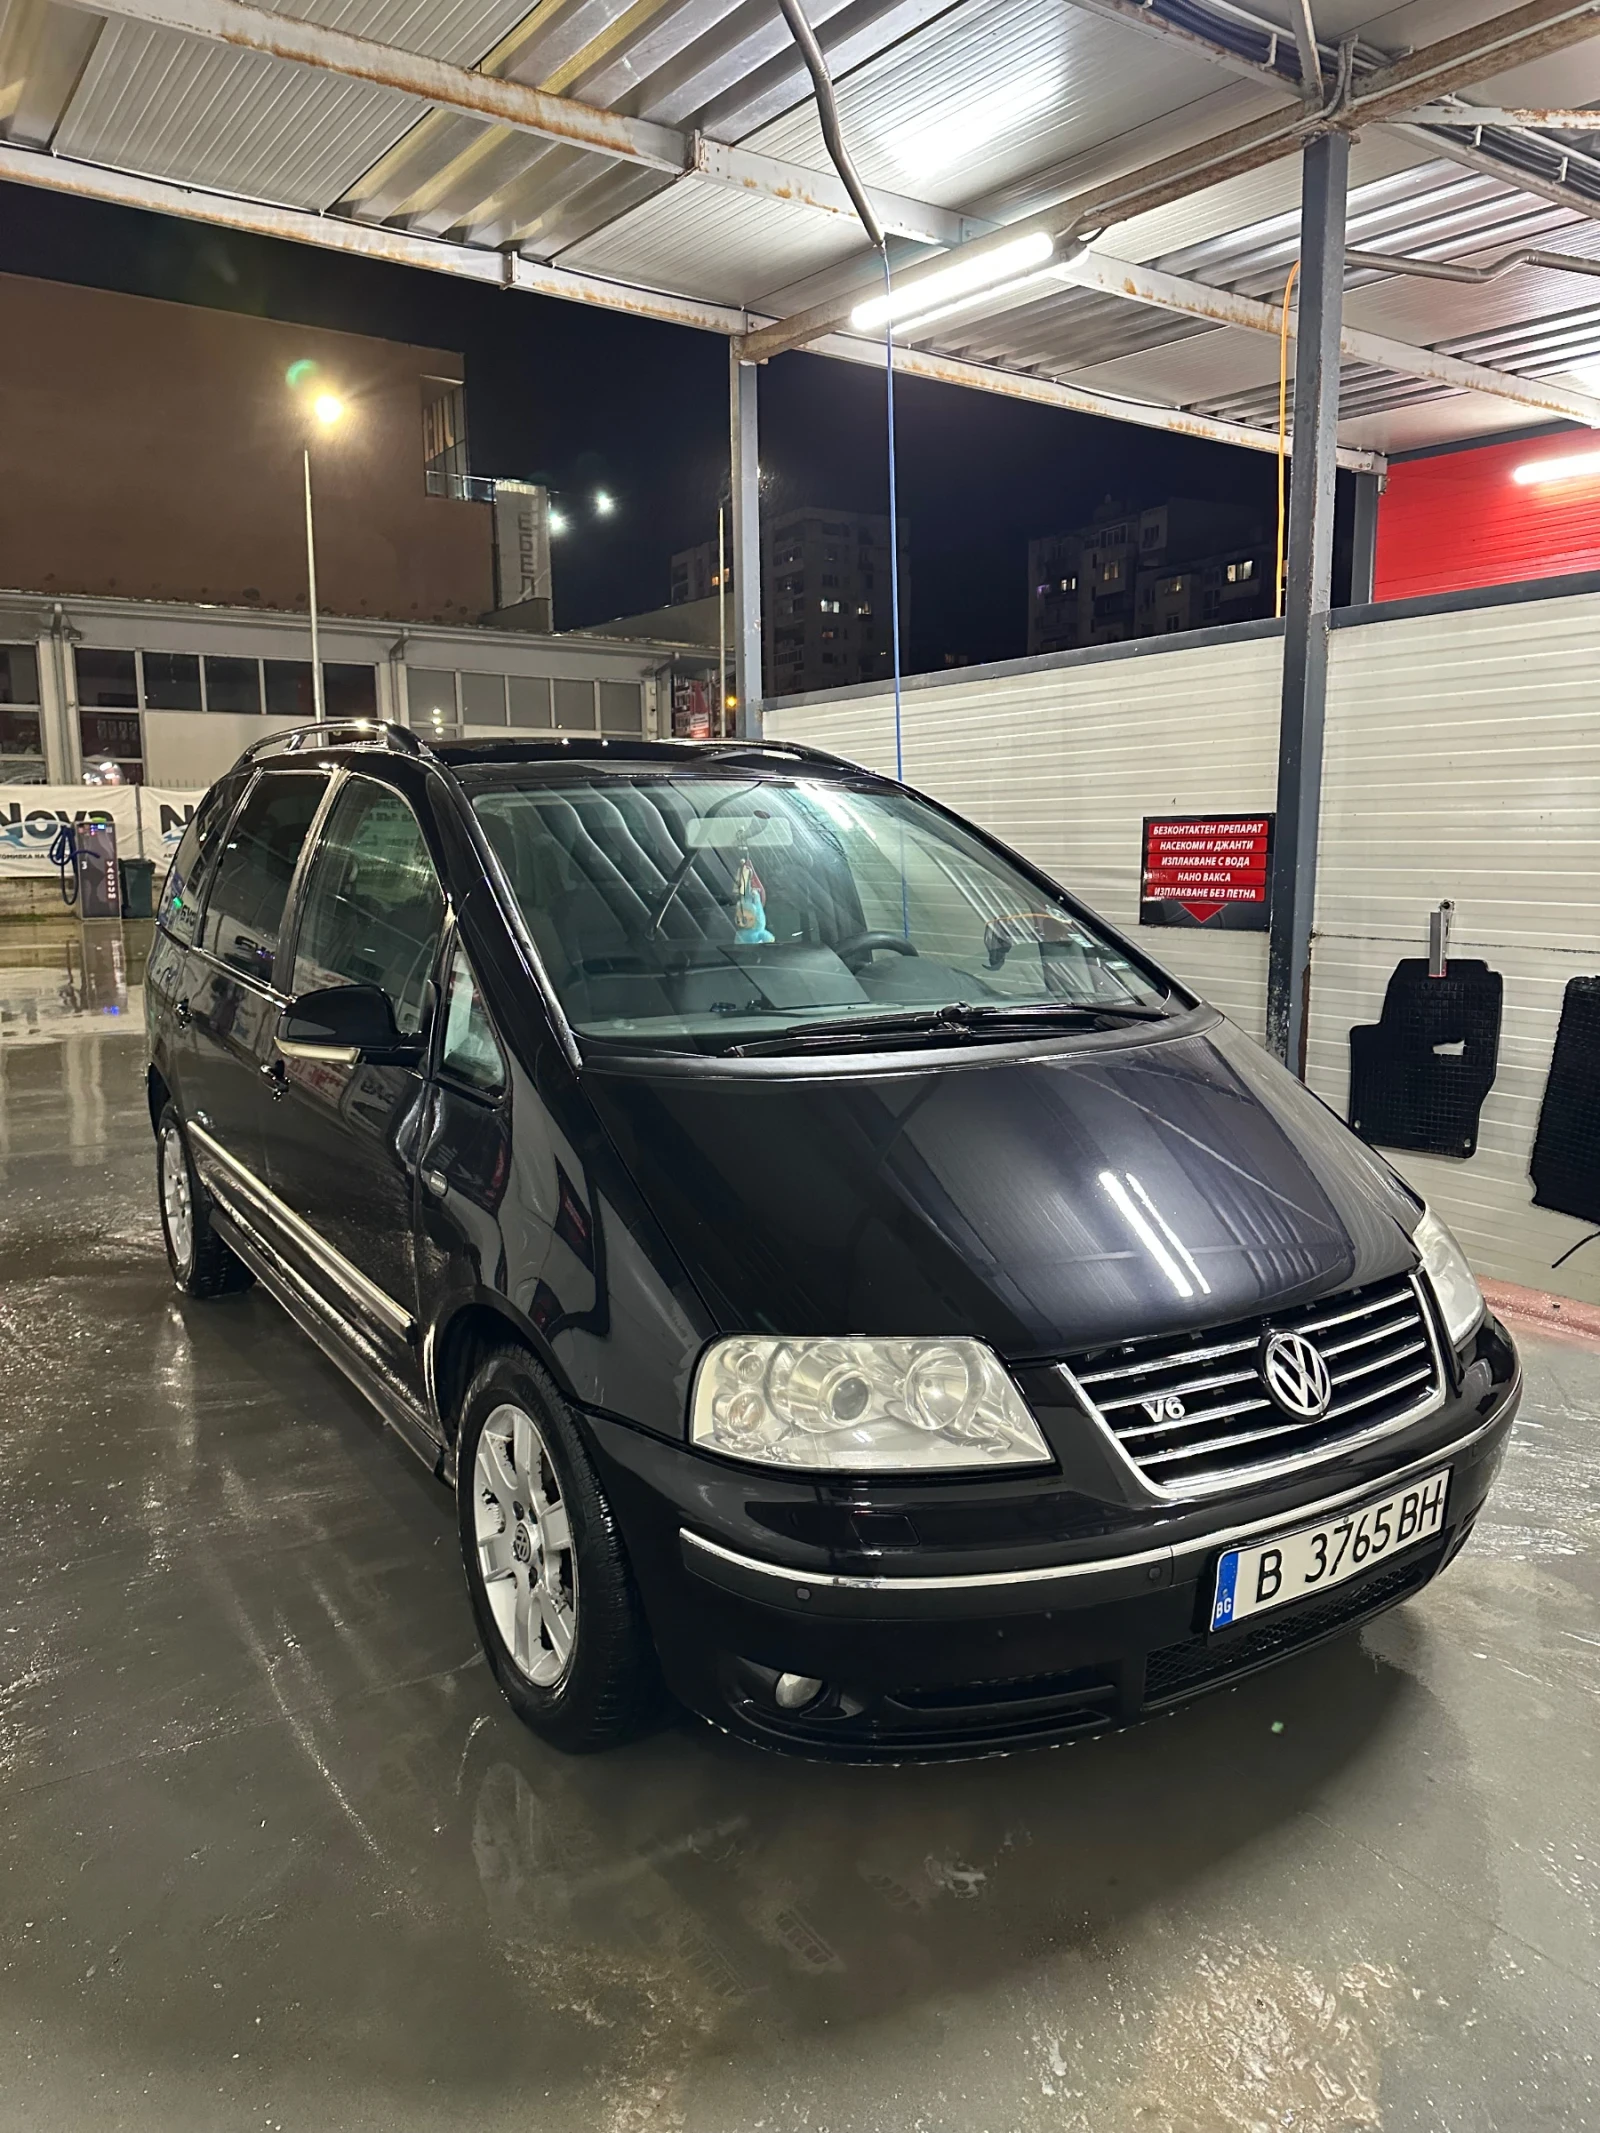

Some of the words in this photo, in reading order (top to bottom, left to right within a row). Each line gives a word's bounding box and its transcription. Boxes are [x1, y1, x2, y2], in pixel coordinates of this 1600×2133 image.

[1153, 824, 1216, 835] БЕЗКОНТАКТЕН
[1217, 823, 1263, 835] ПРЕПАРАТ
[1160, 841, 1205, 851] НАСЕКОМИ
[1206, 841, 1214, 850] И
[1214, 840, 1254, 852] ДЖАНТИ
[81, 861, 88, 870] 3
[1161, 857, 1217, 867] ИЗПЛАКВАНЕ
[1218, 857, 1224, 866] С
[1225, 856, 1250, 868] ВОДА
[106, 860, 117, 899] VACUUM
[1177, 872, 1201, 882] НАНО
[1203, 872, 1231, 882] ВАКСА
[1154, 887, 1208, 898] ИЗПЛАКВАНЕ
[1209, 888, 1225, 898] БЕЗ
[1226, 888, 1256, 899] ПЕТНА
[1141, 1396, 1186, 1423] V6
[1216, 1597, 1232, 1619] BG
